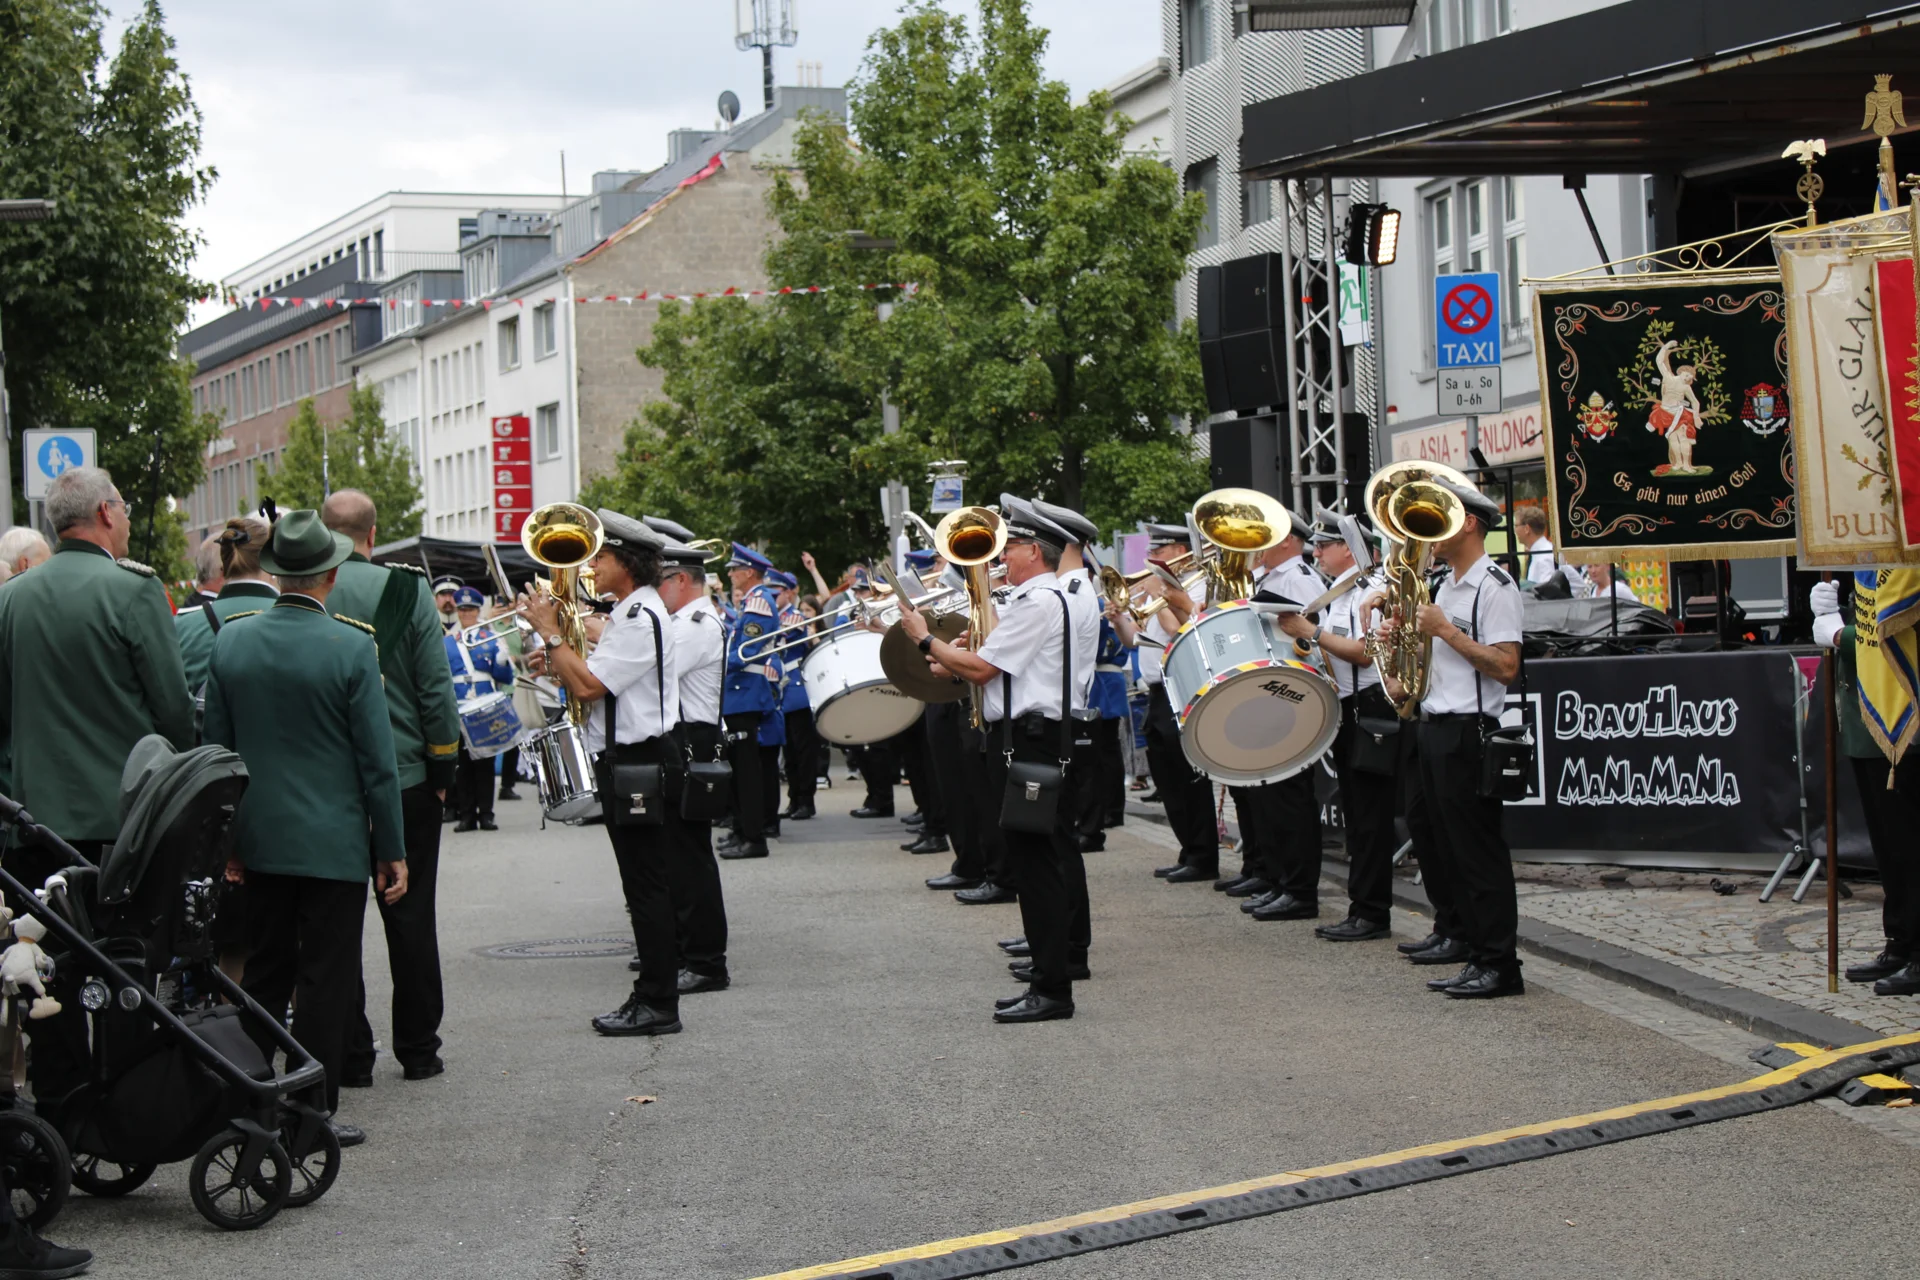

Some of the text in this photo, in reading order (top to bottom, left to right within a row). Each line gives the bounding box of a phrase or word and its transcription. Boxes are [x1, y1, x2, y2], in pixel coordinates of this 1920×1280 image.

[1442, 341, 1494, 364] TAXI
[1446, 376, 1492, 390] Sa u. So
[1456, 393, 1482, 406] 0-6h
[1420, 434, 1451, 463] ASIA
[495, 418, 514, 532] Graef
[1613, 461, 1757, 505] Es gibt nur einen Gott
